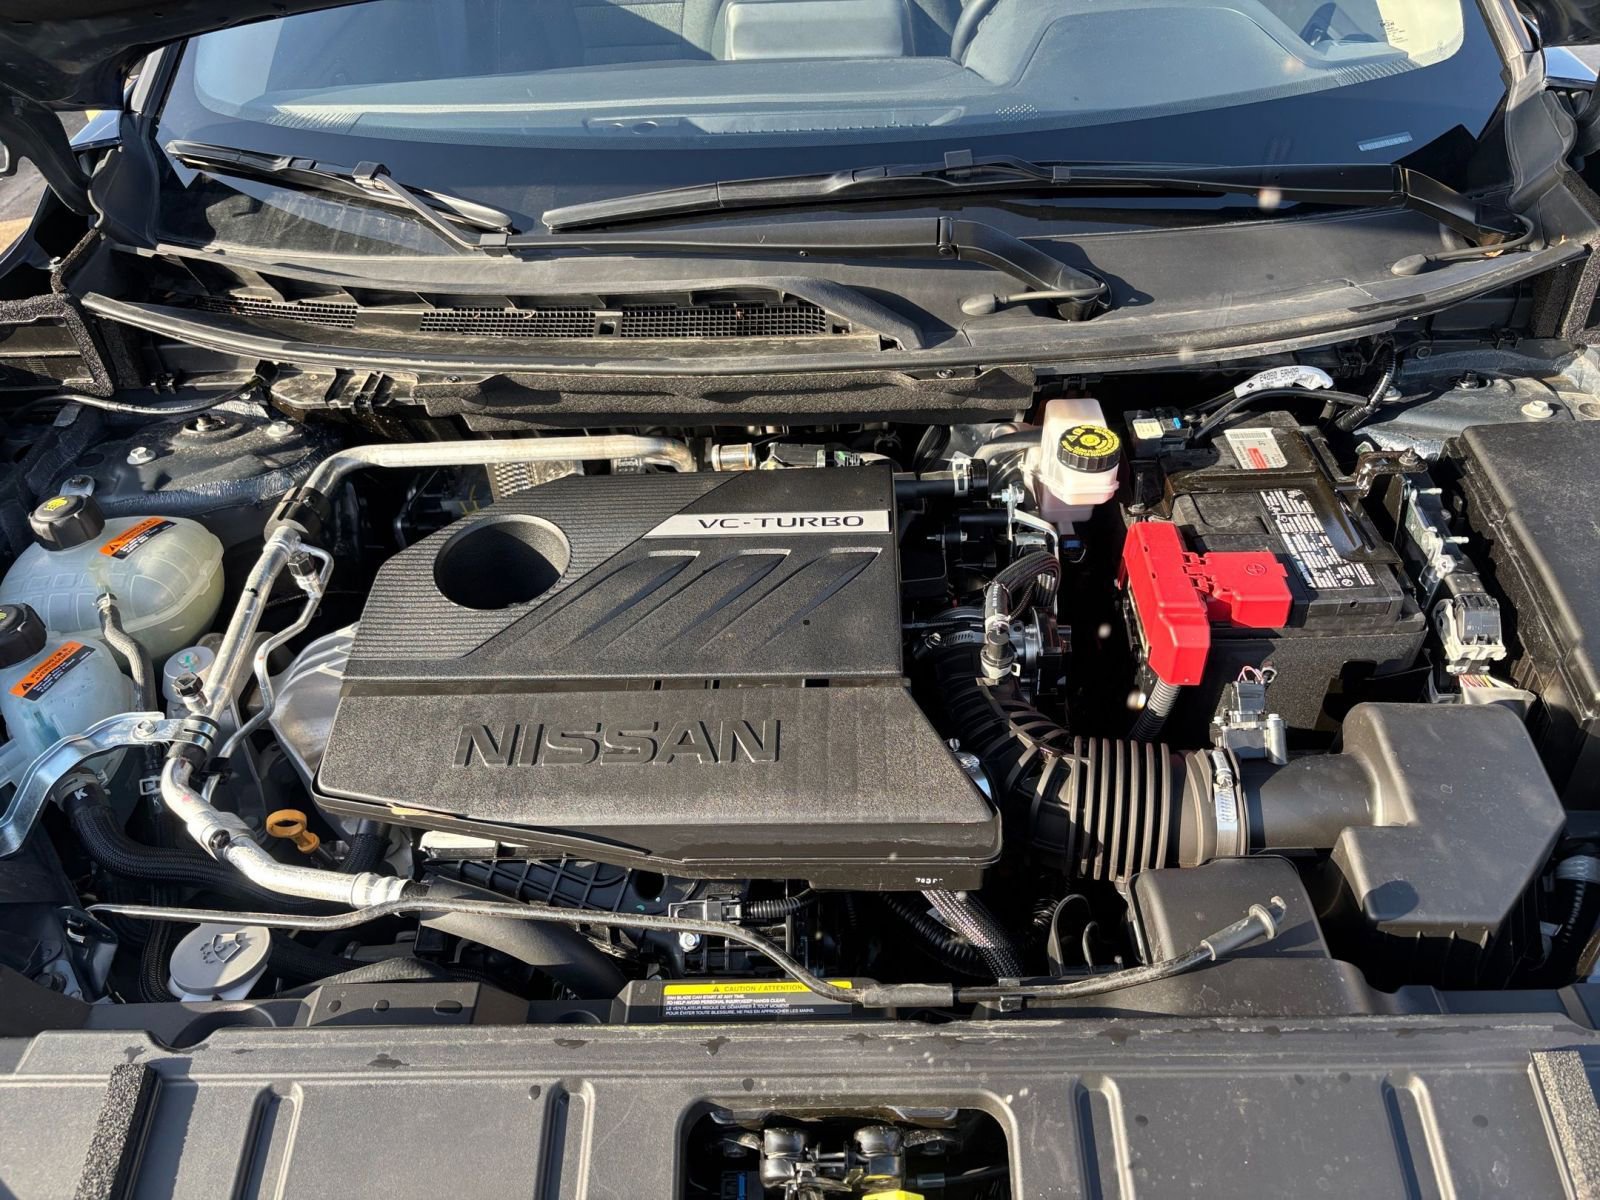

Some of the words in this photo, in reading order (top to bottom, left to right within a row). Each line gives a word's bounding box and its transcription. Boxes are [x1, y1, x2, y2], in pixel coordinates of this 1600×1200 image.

[698, 515, 865, 529] VC-TURBO
[452, 720, 781, 768] NISSAN
[74, 788, 88, 800] K
[152, 796, 160, 806] K
